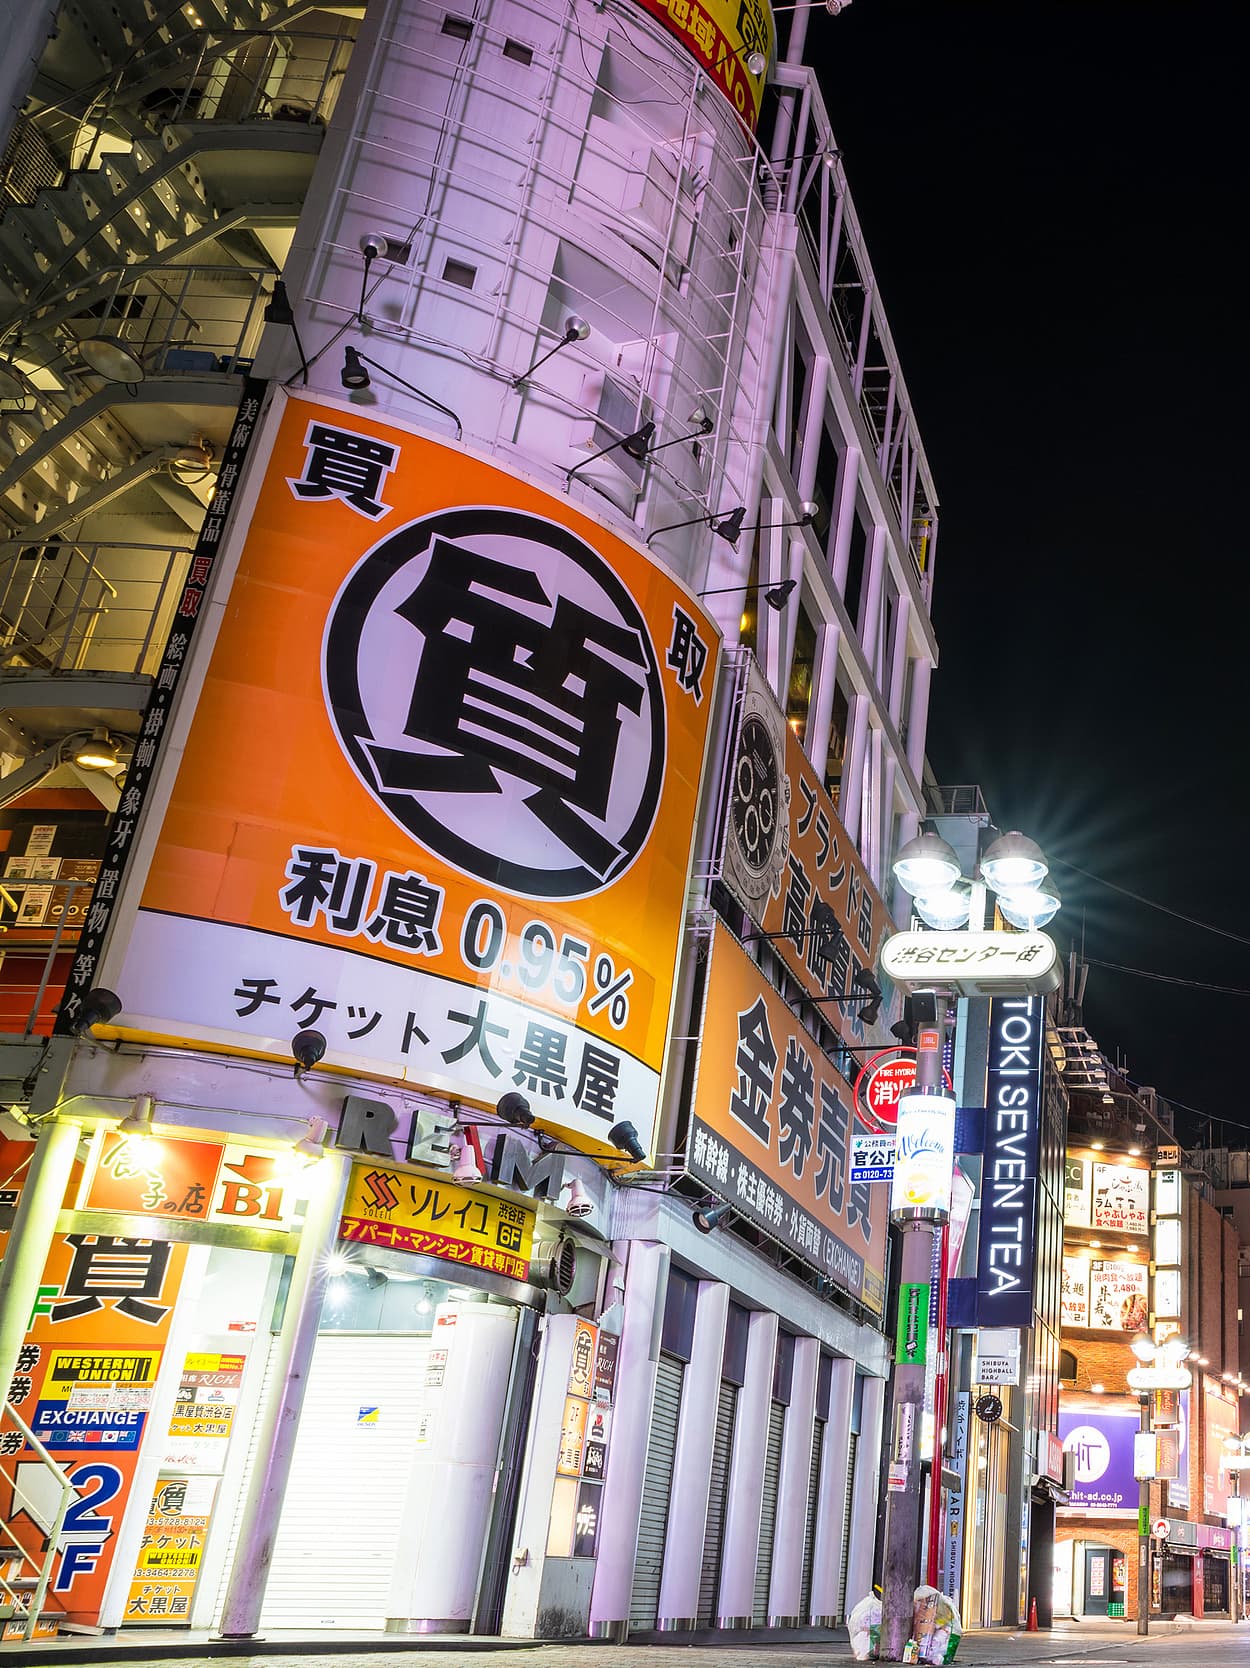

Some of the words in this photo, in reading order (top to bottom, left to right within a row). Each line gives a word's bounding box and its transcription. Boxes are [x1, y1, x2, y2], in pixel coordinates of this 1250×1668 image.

[284, 419, 400, 520] 買
[178, 556, 213, 618] 買取
[666, 601, 711, 706] 取
[356, 533, 650, 881] 質
[797, 774, 873, 958] ブランド品
[279, 844, 447, 957] 利息
[461, 900, 636, 1031] 0.95%
[891, 945, 1044, 963] 渋谷センター街
[1000, 996, 1032, 1075] TOKI
[232, 975, 622, 1125] チケット大黒屋
[880, 1069, 894, 1077] FIRE
[874, 1079, 916, 1105] 消火
[992, 1085, 1029, 1208] SEVEN
[216, 1181, 283, 1221] B1
[410, 1185, 489, 1235] ソレイユ
[363, 1209, 393, 1221] SOLEIL
[498, 1202, 526, 1226] 渋谷店
[1095, 1209, 1146, 1220] しゃぶしゃぶ
[1095, 1219, 1123, 1228] 食べ放題
[341, 1219, 526, 1279] アパート・マンション賃貸専門店
[500, 1225, 521, 1249] 6F
[822, 1234, 861, 1289] (EXCHANGE)
[989, 1217, 1023, 1296] TEA
[57, 1358, 135, 1369] WESTERN
[78, 1369, 135, 1381] UNION
[199, 1374, 239, 1386] RICH
[39, 1410, 140, 1425] EXCHANGE
[172, 1405, 232, 1419] 黒屋質渋谷店
[169, 1423, 228, 1434] ケット大黒屋
[0, 1430, 24, 1455] 券
[1069, 1491, 1123, 1503] .hit-ad.co.jp
[141, 1535, 201, 1549] チケット
[143, 1585, 181, 1595] チケット
[129, 1596, 188, 1614] 大黒屋
